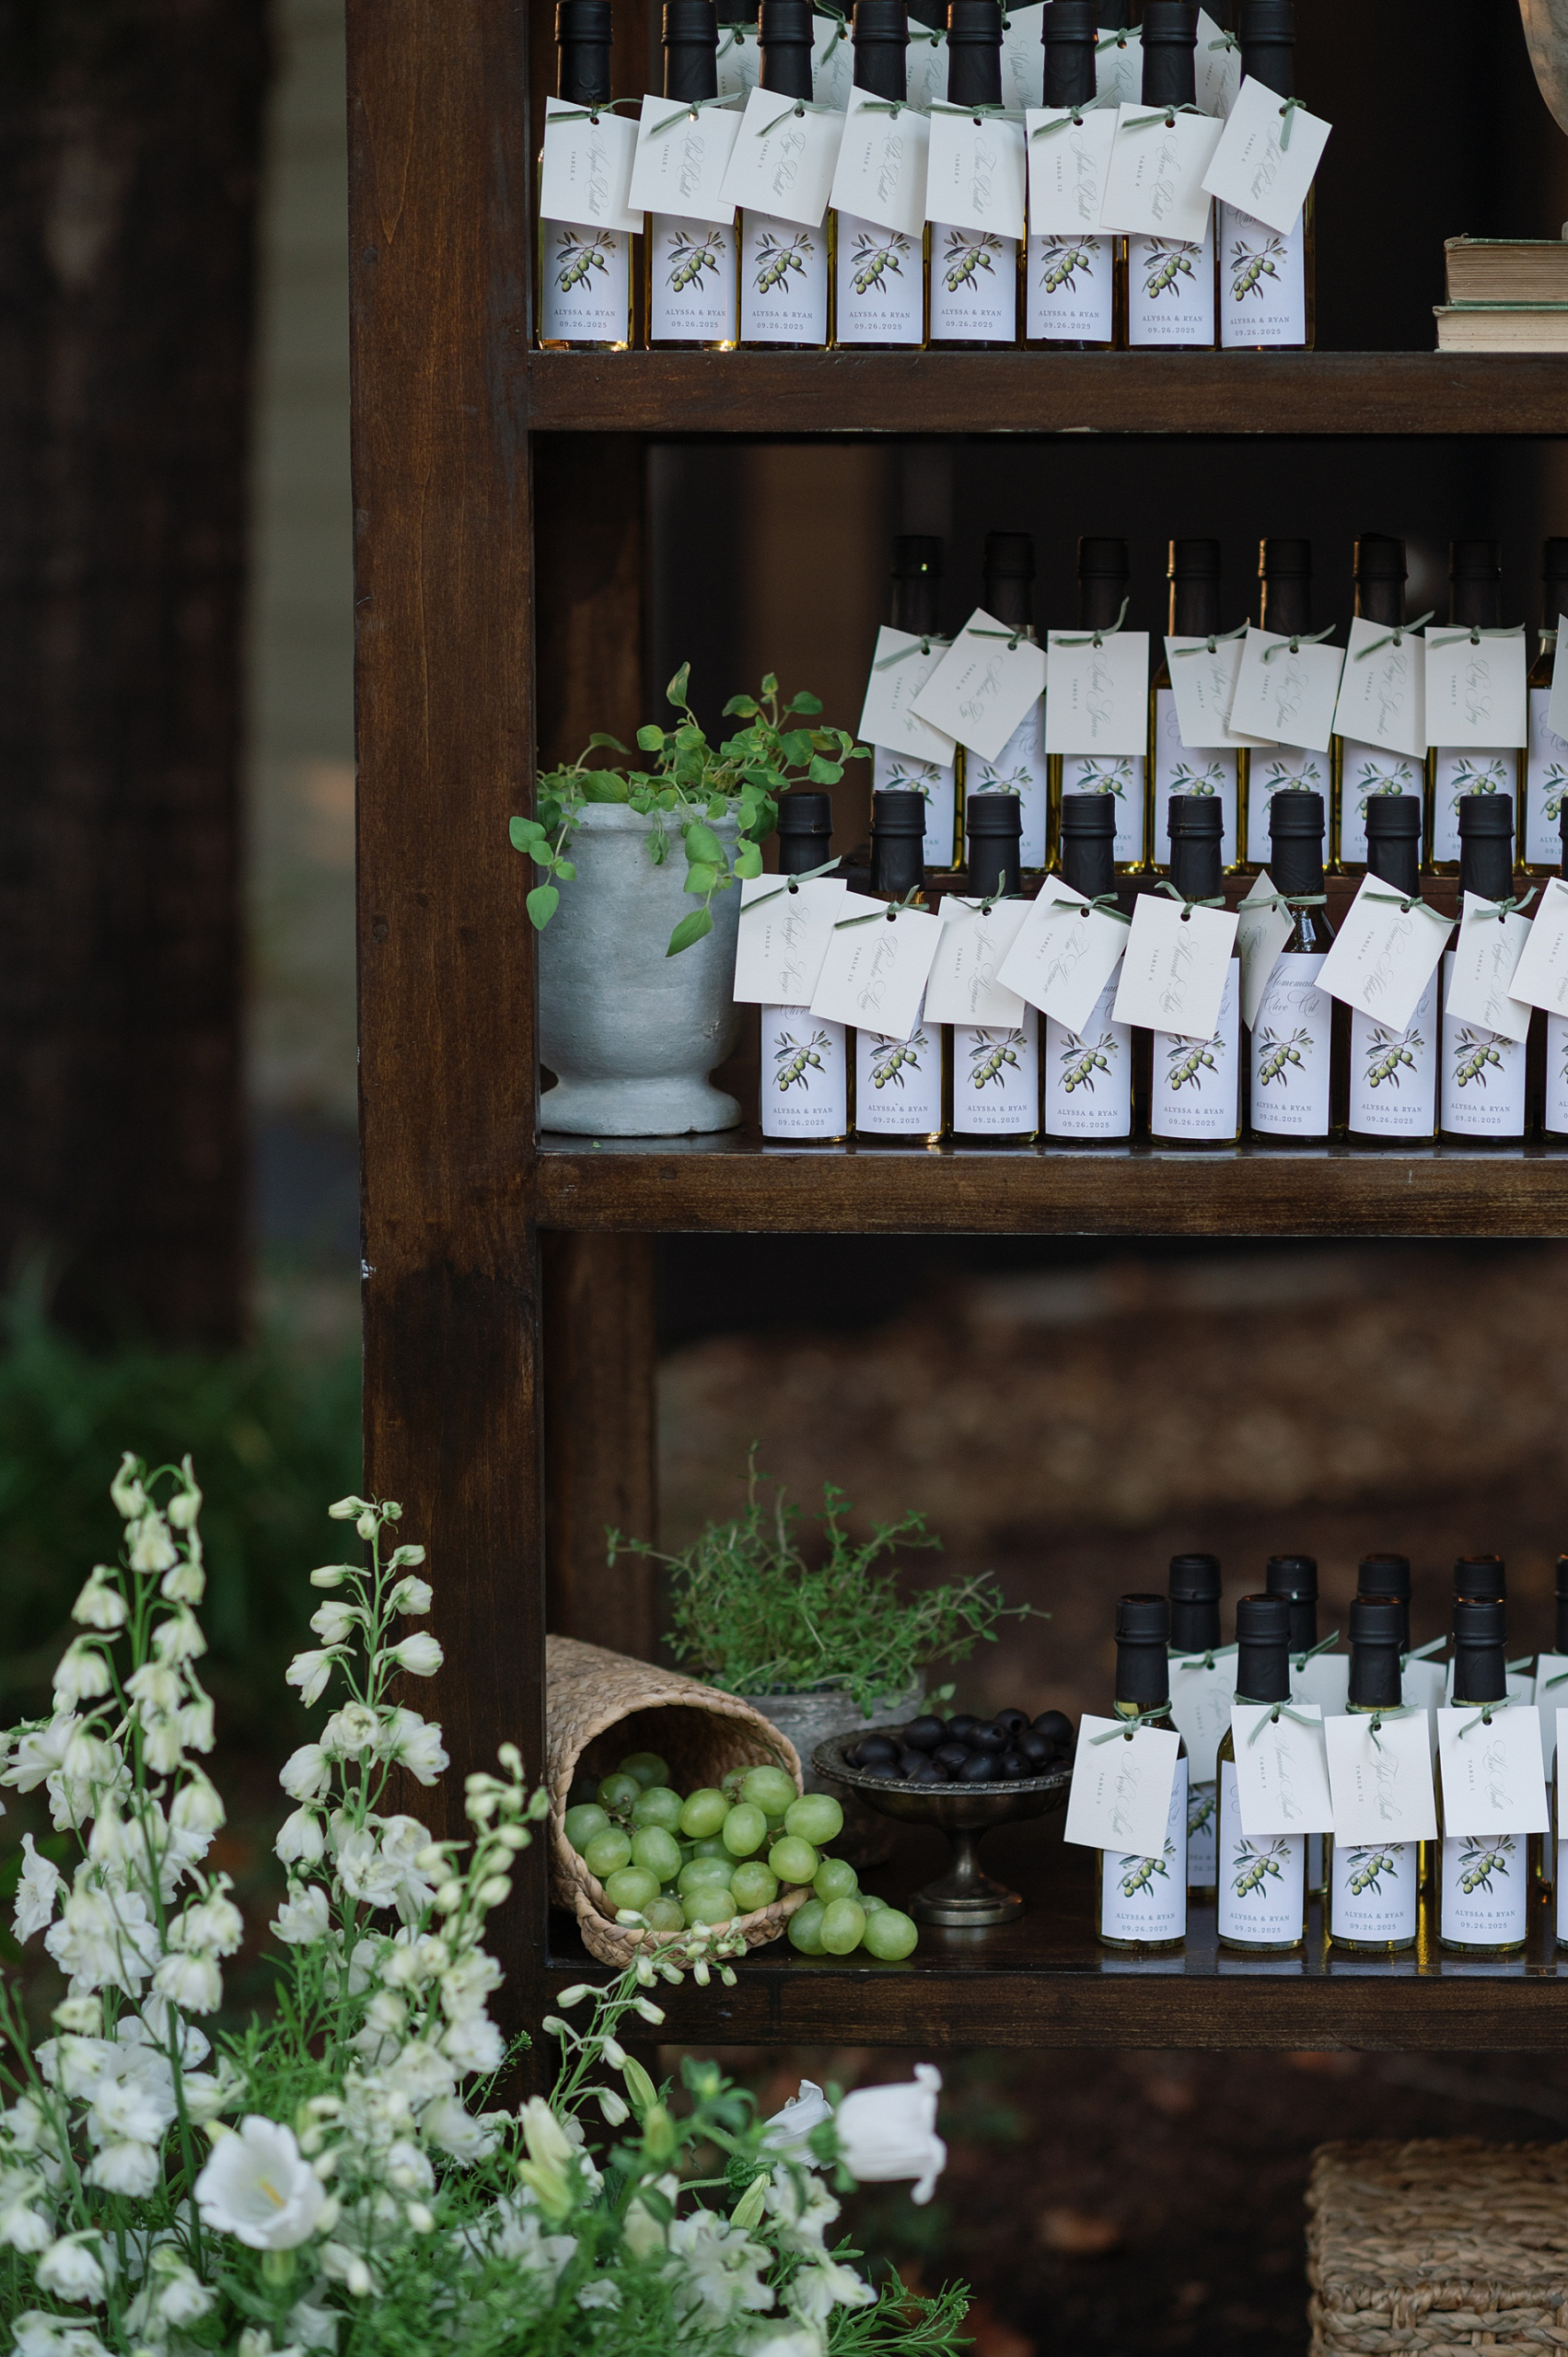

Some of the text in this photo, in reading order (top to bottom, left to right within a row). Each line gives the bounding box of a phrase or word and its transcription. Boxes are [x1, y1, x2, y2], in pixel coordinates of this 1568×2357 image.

[1136, 155, 1145, 179] TABLE
[584, 129, 611, 216] Angela Bartlett
[772, 154, 798, 197] Bartlett
[968, 136, 997, 215] Tina Bartlett
[1069, 131, 1099, 221] Justin Bartlett
[676, 157, 704, 199] Bartlett
[876, 157, 901, 203] Bartlett
[1149, 134, 1181, 222] Steven Bartlett
[1249, 156, 1277, 201] Bartlett
[552, 308, 583, 317] ALYSSA
[791, 311, 813, 319] RYAN
[848, 310, 878, 319] ALYSSA
[1078, 310, 1099, 319] RYAN
[558, 319, 608, 330] 09.26.2025
[669, 320, 719, 329] 09.26.2025
[945, 320, 993, 329] 09.26.2025
[1042, 321, 1091, 330] 09.26.2025
[1228, 317, 1257, 325] ALYSSA
[755, 322, 804, 331] 09.26.2025
[853, 322, 902, 331] 09.26.2025
[1234, 327, 1281, 336] 09.26.2025
[1086, 651, 1114, 692] Sarah
[1063, 921, 1090, 958] Tom
[1169, 924, 1199, 981] Hannah
[851, 946, 862, 970] TABLE
[955, 946, 963, 971] TABLE
[1149, 948, 1159, 973] TABLE
[1362, 917, 1413, 1004] Vanessa Mitchell
[856, 932, 899, 1013] Brandon Lane
[1266, 965, 1316, 988] Homemad
[1287, 991, 1320, 1017] Oil
[772, 1106, 801, 1115] ALYSSA
[867, 1104, 898, 1112] ALYSSA
[1007, 1104, 1028, 1112] RYAN
[1162, 1106, 1192, 1114] ALYSSA
[1255, 1101, 1279, 1112] ALYSSA
[1290, 1104, 1312, 1112] RYAN
[1360, 1103, 1390, 1111] ALYSSA
[1449, 1101, 1479, 1111] ALYSSA
[1057, 1109, 1086, 1117] ALYSSA
[1258, 1112, 1303, 1124] 09.26.2025
[972, 1116, 1020, 1124] 09.26.2025
[1168, 1118, 1216, 1127] 09.26.2025
[1365, 1115, 1414, 1124] 09.26.2025
[1454, 1114, 1502, 1124] 09.26.2025
[1063, 1120, 1109, 1129] 09.26.2025
[1272, 1724, 1303, 1820] Amanda Smith
[1481, 1739, 1514, 1809] Lisa Smith
[1108, 1750, 1141, 1837] Kevin Smith
[1373, 1780, 1402, 1821] Smith
[1114, 1913, 1145, 1922] ALYSSA
[1156, 1912, 1177, 1921] RYAN
[1228, 1912, 1259, 1921] ALYSSA
[1270, 1914, 1290, 1922] RYAN
[1344, 1910, 1374, 1919] ALYSSA
[1455, 1910, 1485, 1918] ALYSSA
[1495, 1910, 1516, 1918] RYAN
[1121, 1923, 1169, 1933] 09.26.2025
[1234, 1925, 1282, 1933] 09.26.2025
[1459, 1922, 1508, 1930] 09.26.2025
